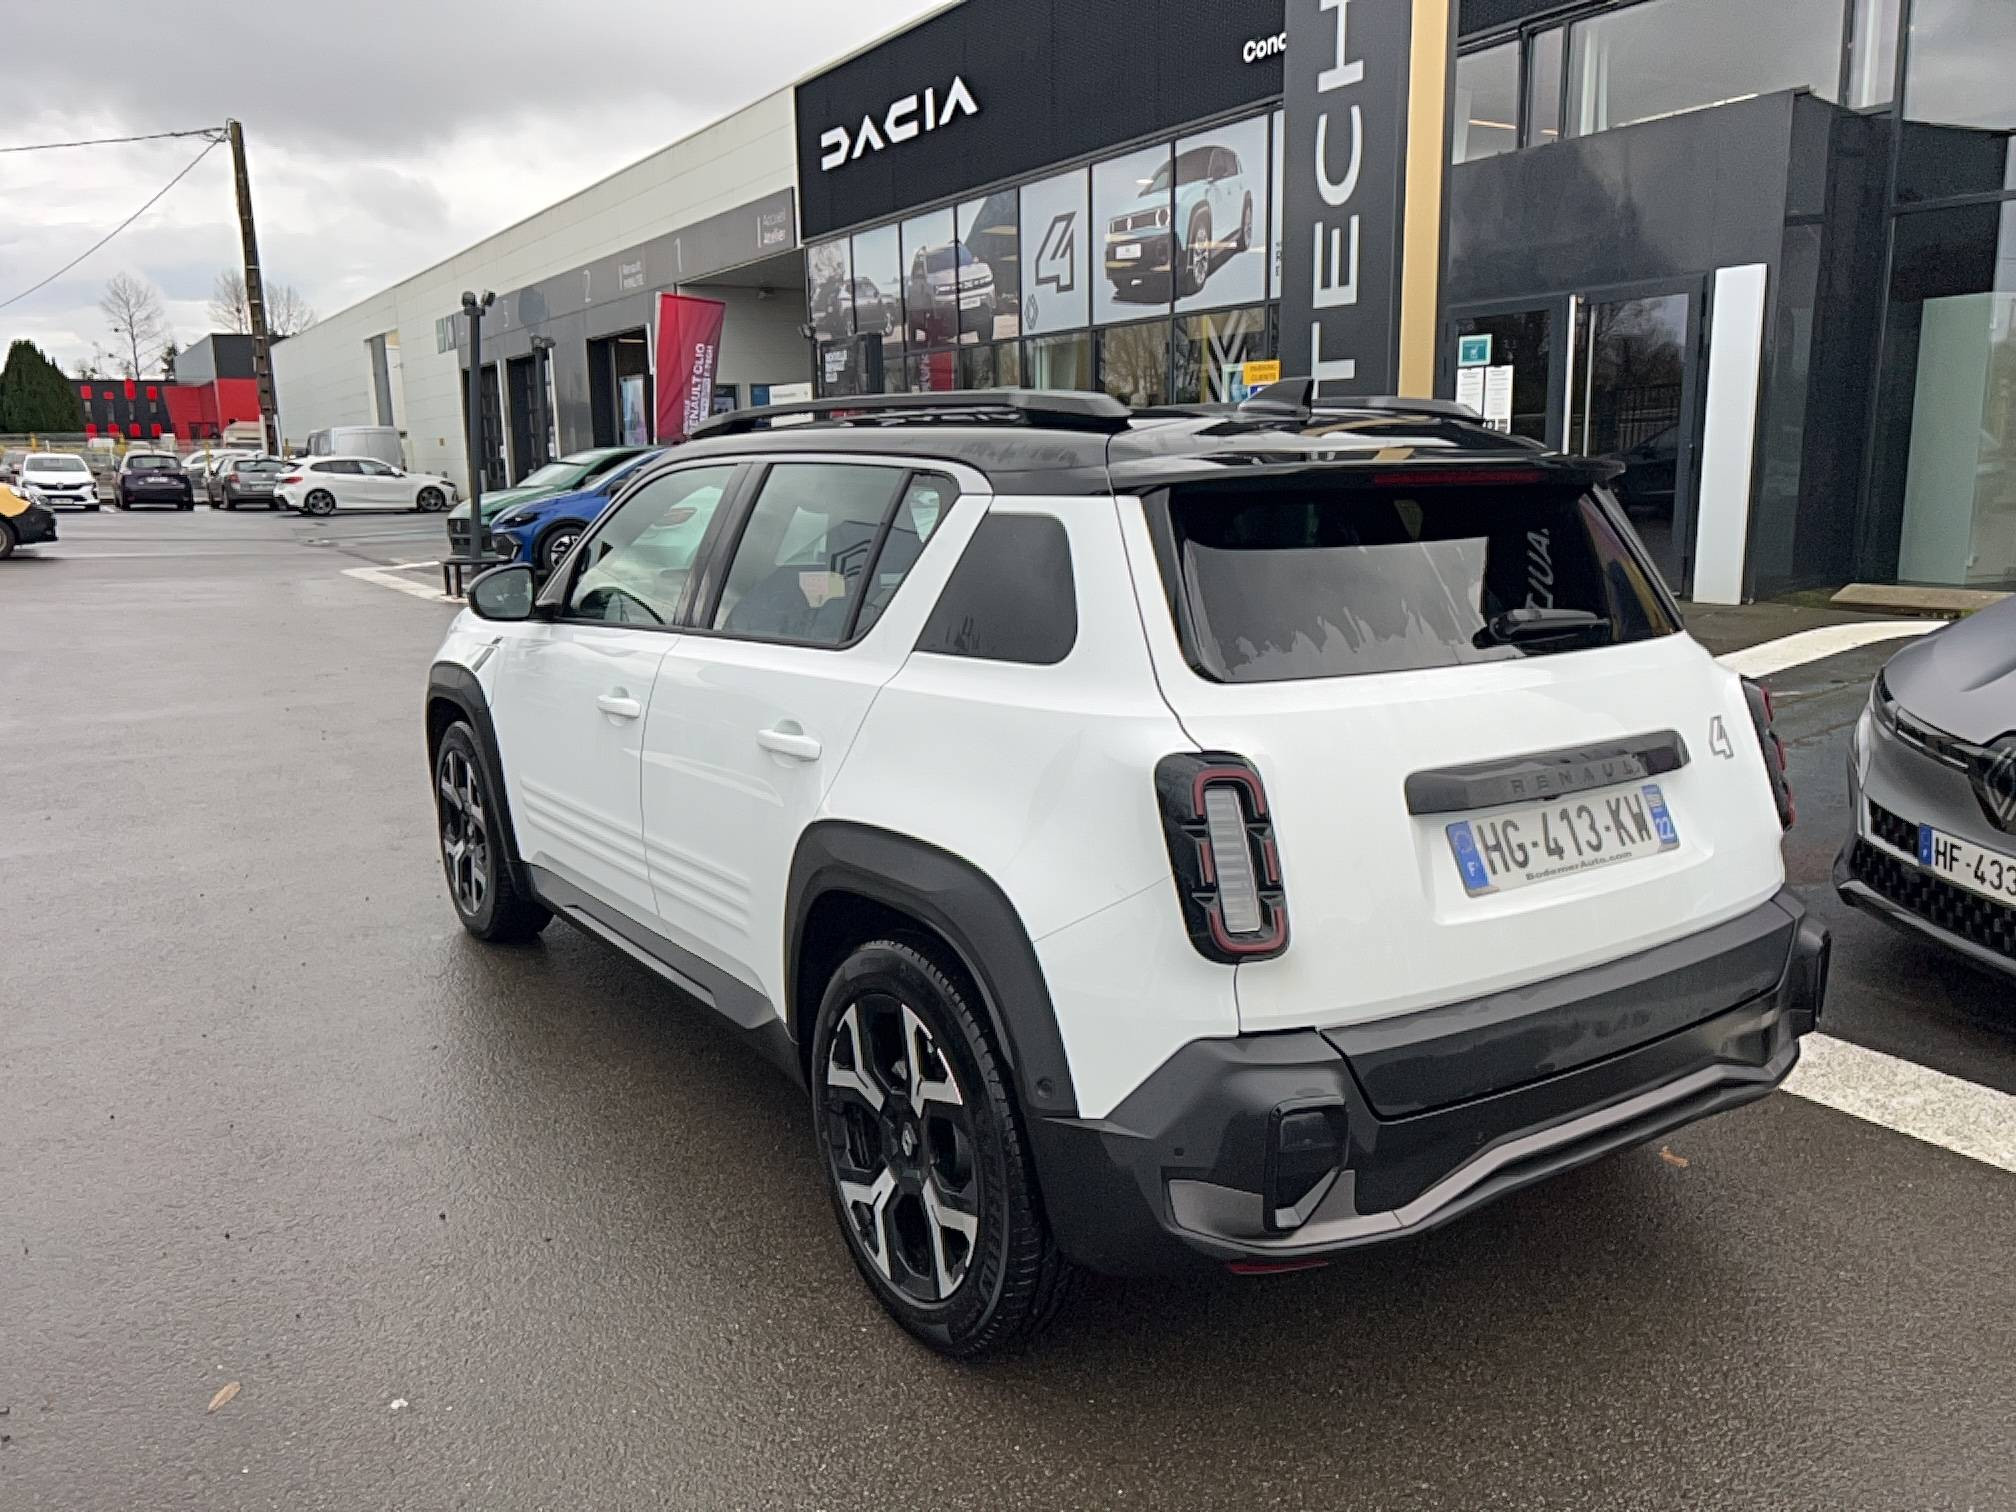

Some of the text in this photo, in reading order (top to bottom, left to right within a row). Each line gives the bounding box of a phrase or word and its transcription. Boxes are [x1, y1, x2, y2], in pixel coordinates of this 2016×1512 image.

[820, 75, 978, 172] DACIA
[692, 342, 705, 375] CLIO
[1476, 793, 1652, 875] HG-413-KW
